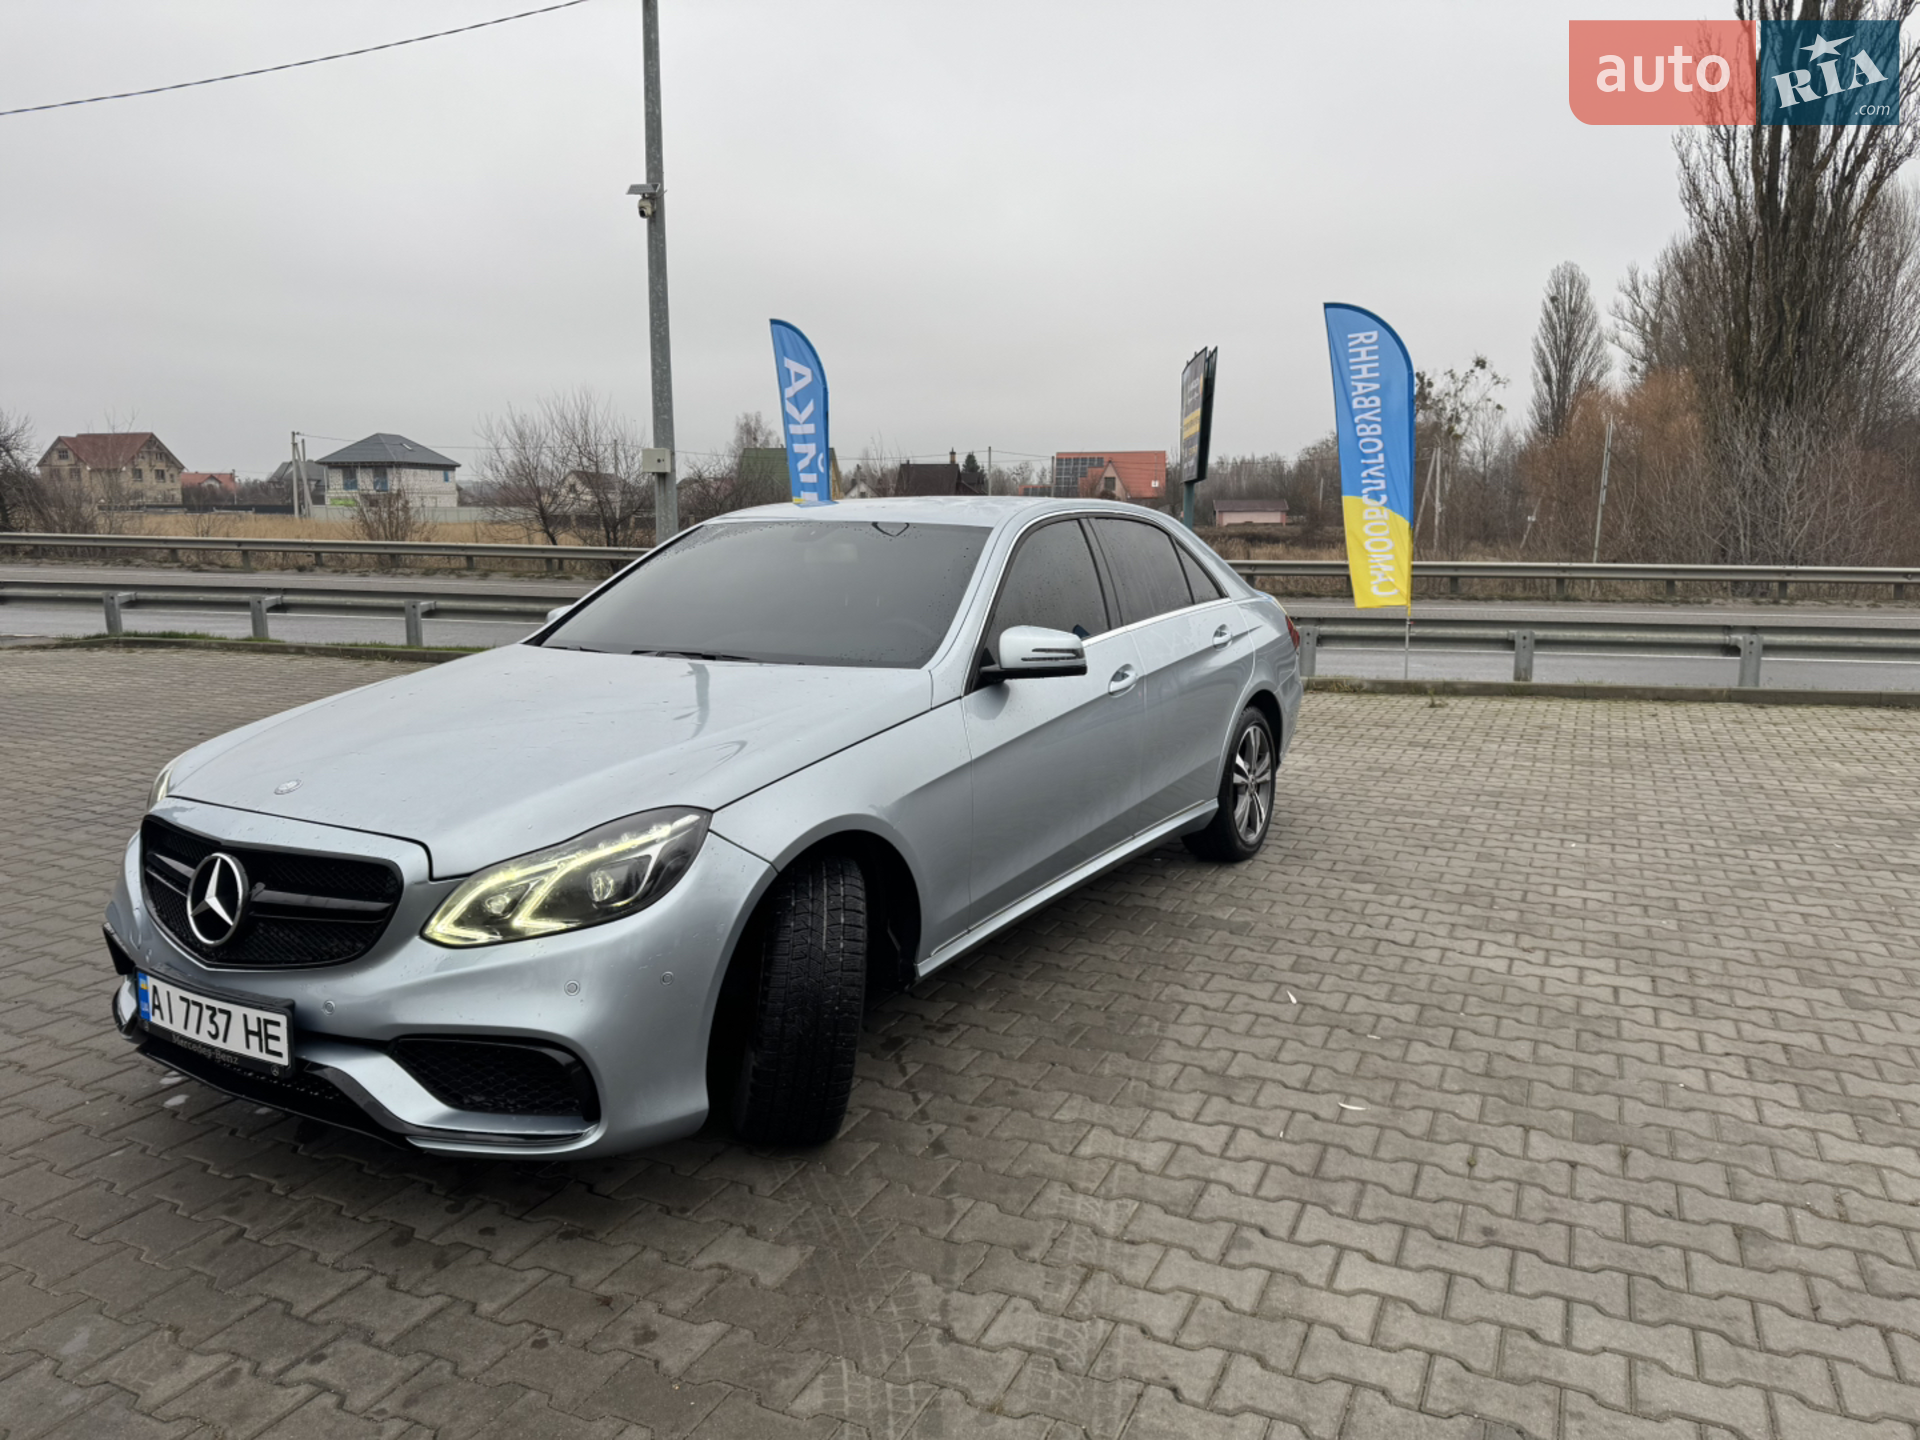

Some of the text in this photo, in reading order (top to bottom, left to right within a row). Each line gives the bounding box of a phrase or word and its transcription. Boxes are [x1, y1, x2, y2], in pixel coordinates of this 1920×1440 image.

[151, 984, 283, 1059] AI 7737 HE
